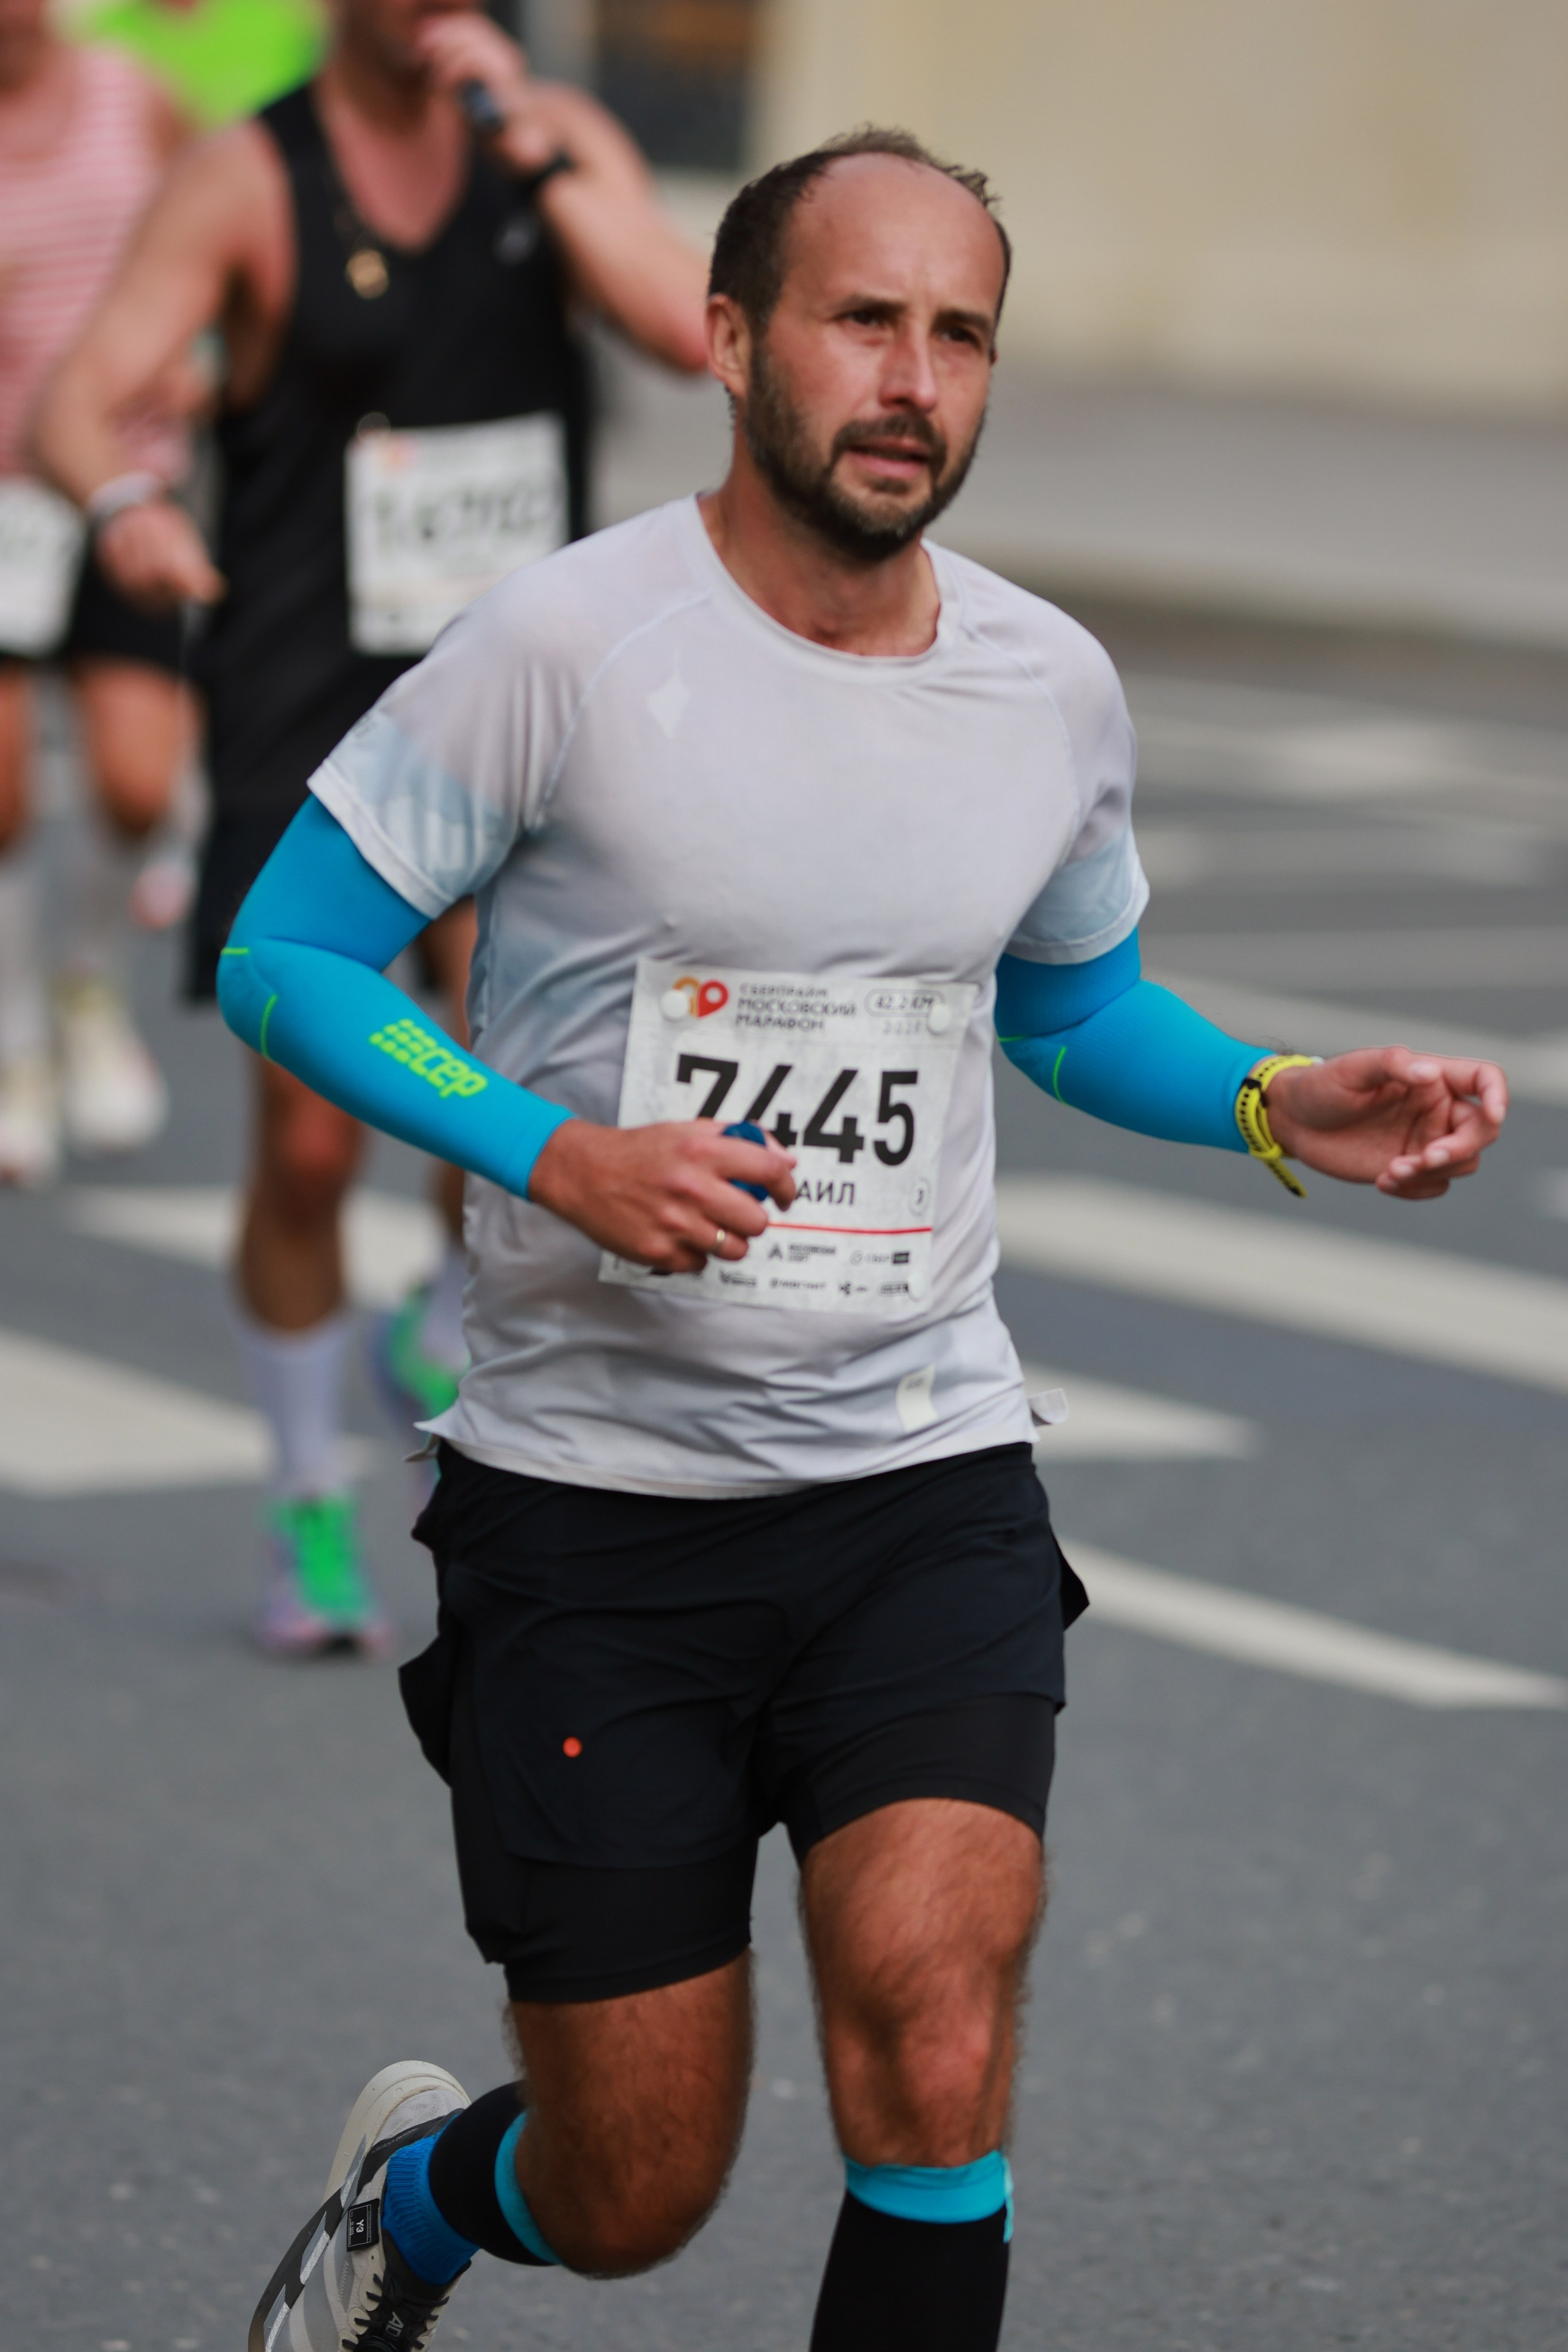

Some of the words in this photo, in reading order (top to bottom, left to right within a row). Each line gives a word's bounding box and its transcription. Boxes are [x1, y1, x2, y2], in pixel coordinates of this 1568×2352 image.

[738, 997, 857, 1016] МОСКОВСКИЙ
[736, 1013, 824, 1031] МАРАФОН
[408, 1048, 488, 1098] cep
[676, 1054, 919, 1166] 7445
[796, 1180, 855, 1205] АИЛ
